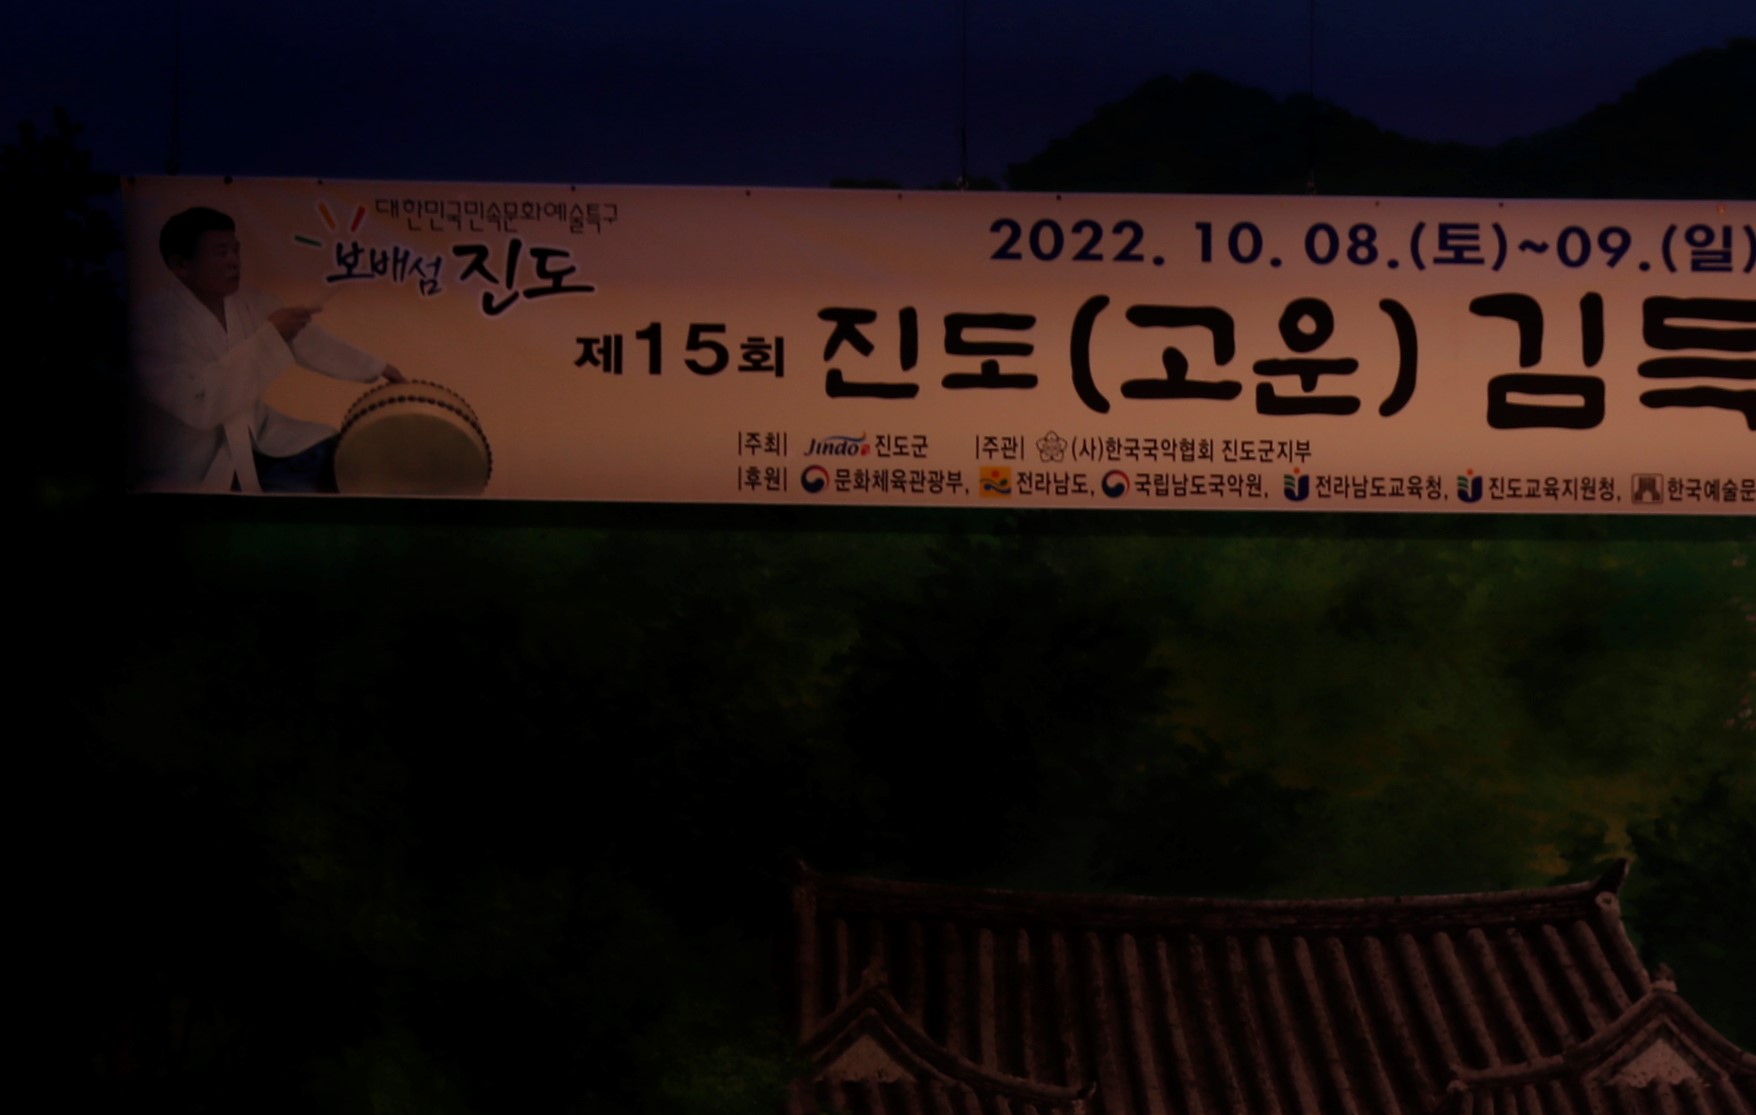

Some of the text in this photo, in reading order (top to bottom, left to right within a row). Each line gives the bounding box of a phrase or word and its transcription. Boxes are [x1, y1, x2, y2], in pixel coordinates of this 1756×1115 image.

[375, 199, 619, 233] 대한민국민속문화예술특구
[989, 218, 1165, 266] 2022.
[1195, 221, 1283, 267] 10.
[327, 238, 595, 316] 보배섬 진도
[574, 322, 787, 378] 제15회
[817, 294, 1418, 416] 진도(고운)
[803, 434, 859, 457] Jindo
[875, 434, 928, 458] 진도군
[1071, 436, 1312, 463] (사)한국국악협회 진도군지부
[834, 468, 970, 495] 문화체육관광부,
[1016, 471, 1095, 497] 전라남도,
[1134, 473, 1268, 499] 국립남도국악원,
[1315, 475, 1448, 500] 전라남도교육청,
[1489, 476, 1621, 503] 진도교육지원청,
